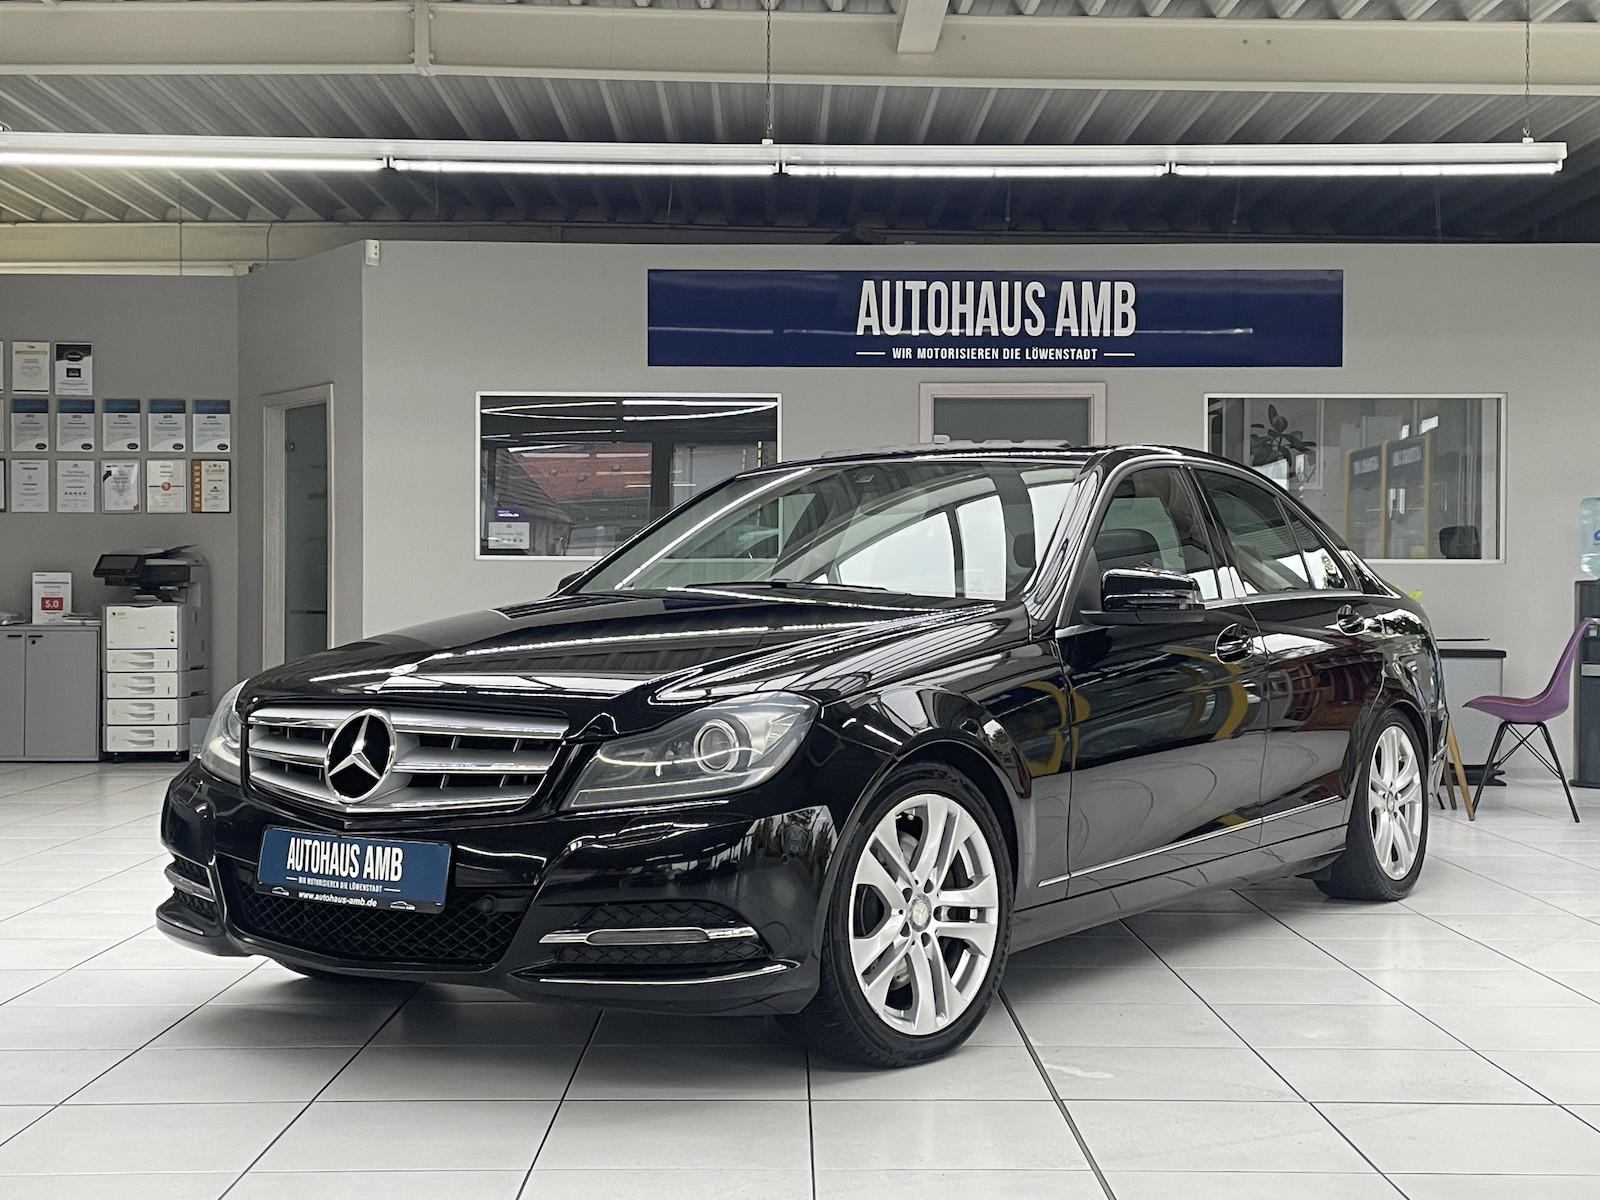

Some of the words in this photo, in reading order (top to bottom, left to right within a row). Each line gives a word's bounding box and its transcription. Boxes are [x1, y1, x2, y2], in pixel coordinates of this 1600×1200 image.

[856, 280, 1046, 337] AUTOHAUS
[1054, 280, 1137, 337] AMB
[892, 347, 913, 360] WIR
[917, 347, 999, 361] MOTORISIEREN
[1002, 347, 1021, 360] DIE
[1025, 346, 1099, 361] LÖWENSTADT
[286, 837, 360, 879] AUTOHAUS
[363, 845, 404, 882] AMB
[298, 890, 378, 907] www.autohaus-amb.de
